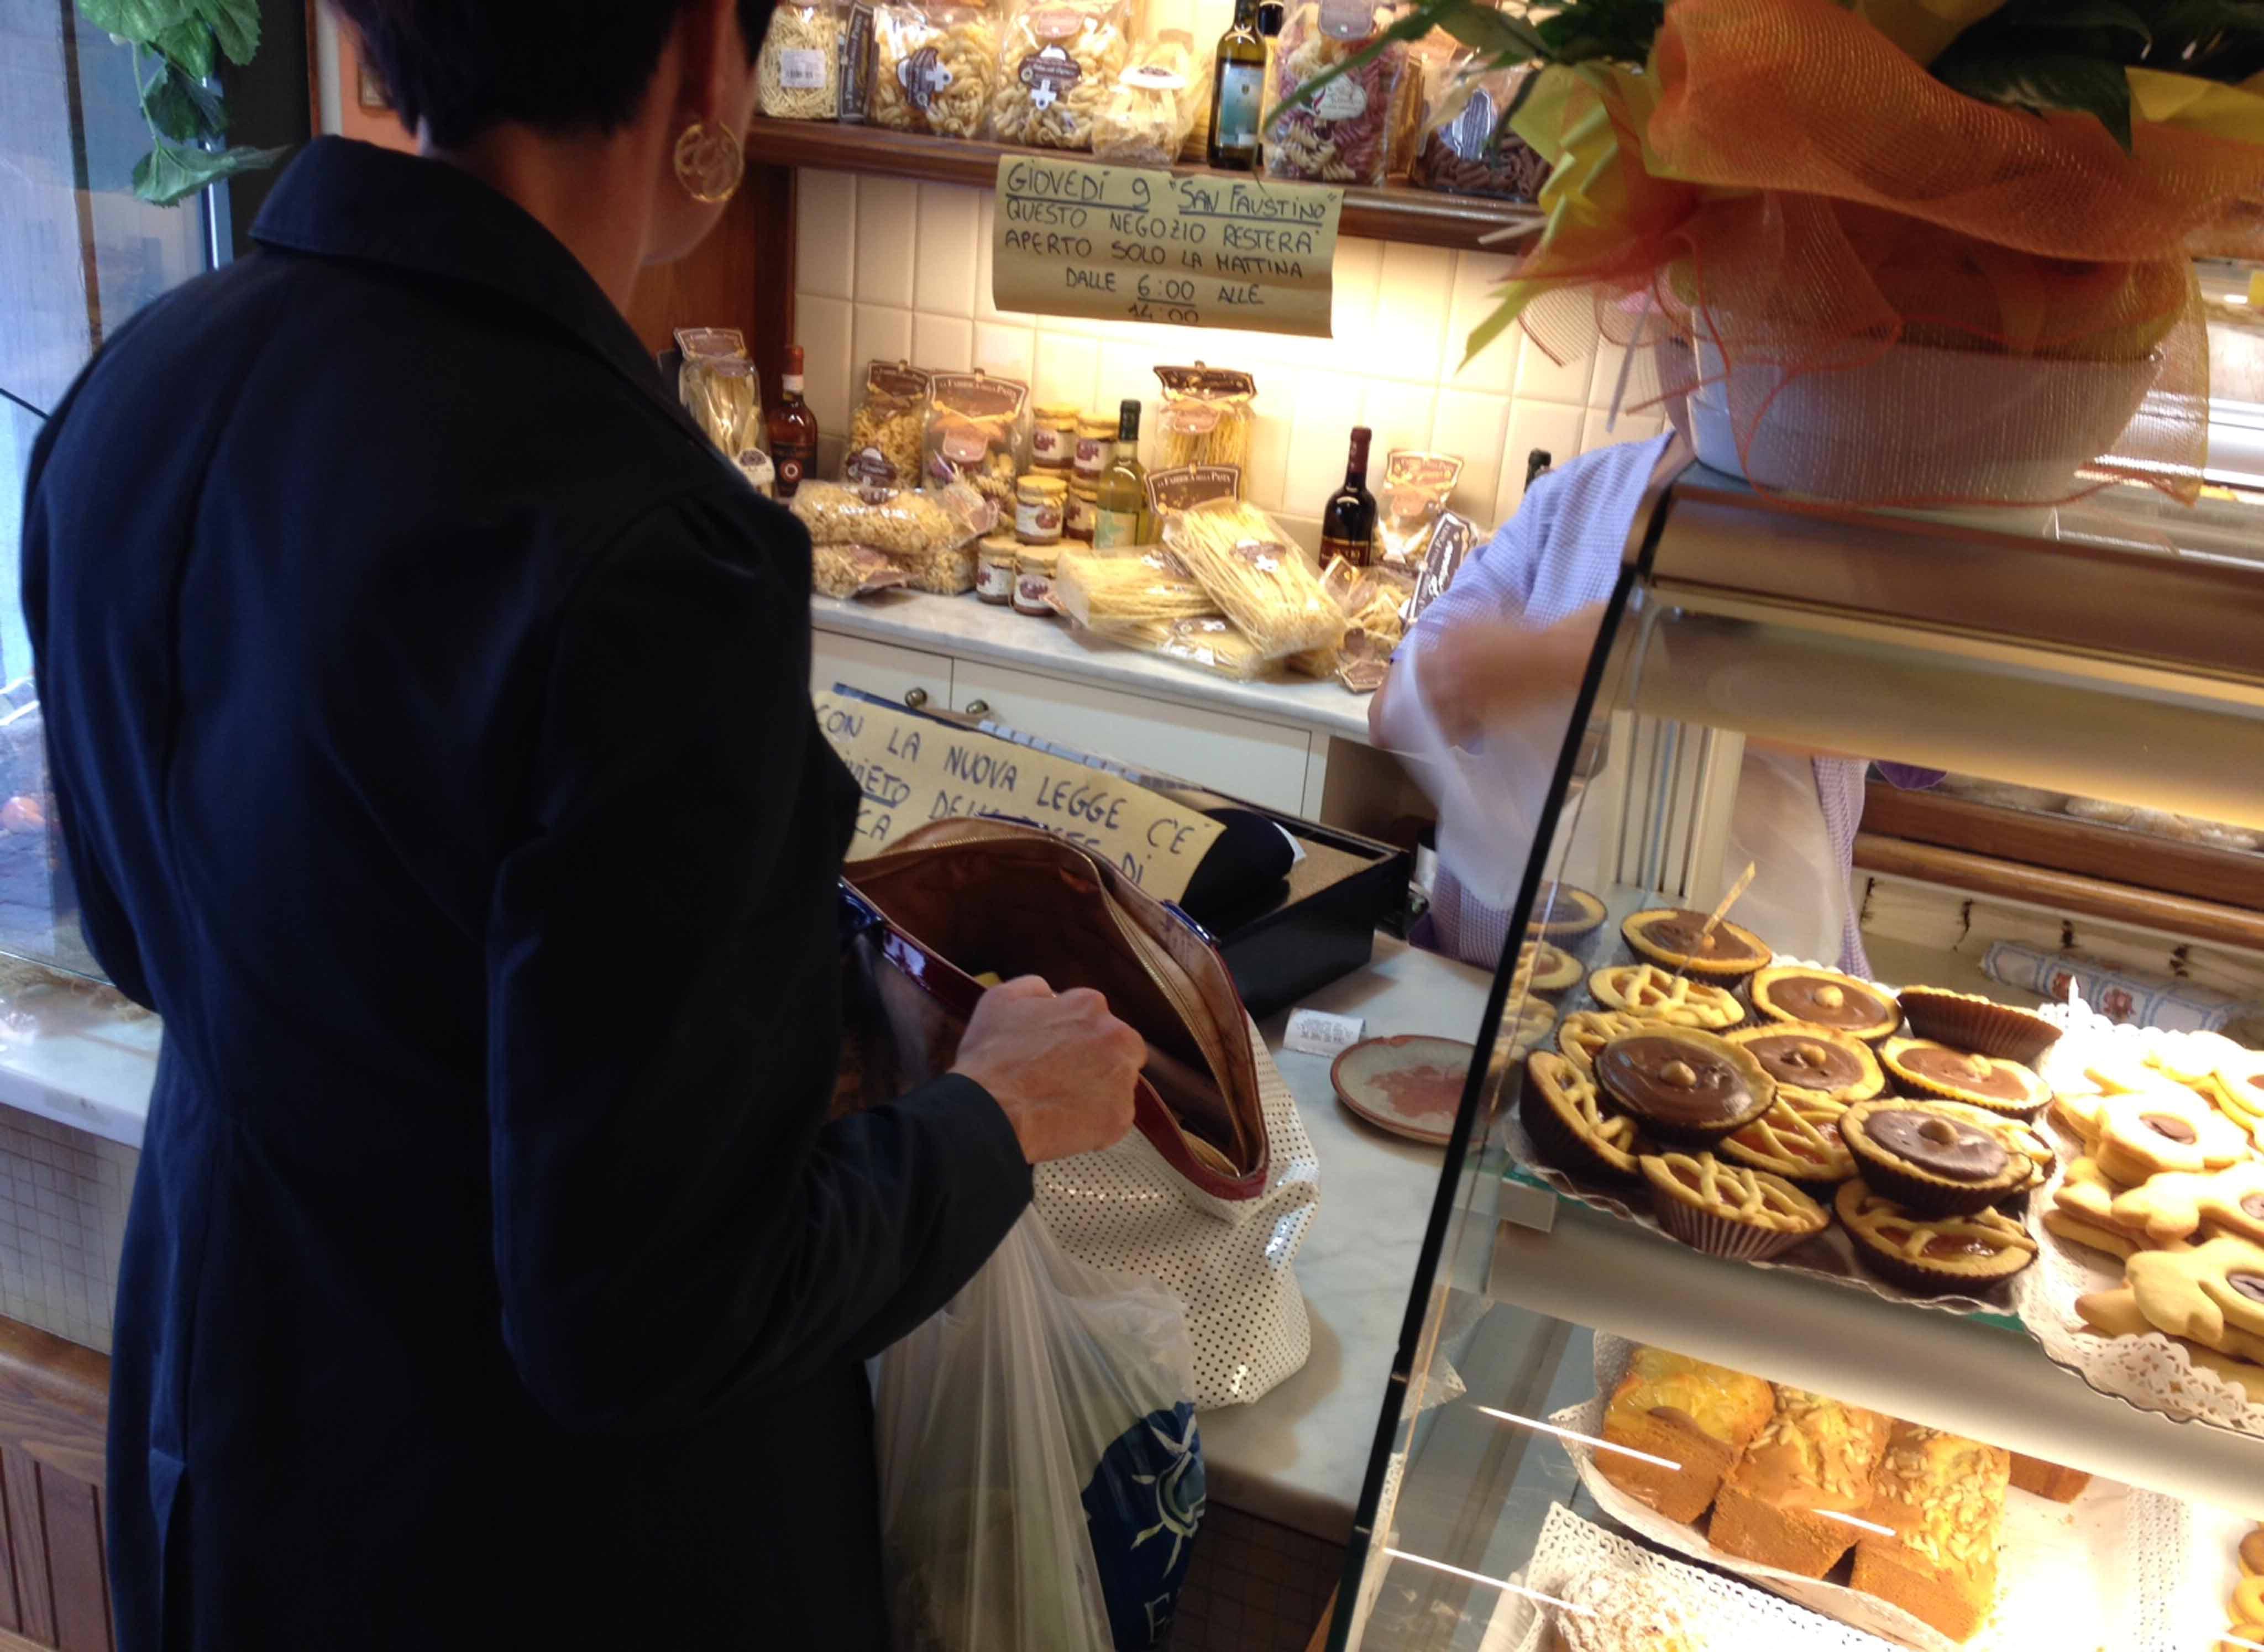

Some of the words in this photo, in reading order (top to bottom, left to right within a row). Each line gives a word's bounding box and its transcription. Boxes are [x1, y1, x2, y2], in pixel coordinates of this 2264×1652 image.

[1131, 177, 1151, 207] 9
[1006, 197, 1087, 229] QUESTO
[1110, 212, 1206, 244] NEGOZIO
[1005, 228, 1092, 258] APERTO
[1111, 240, 1166, 265] SOLO
[1181, 250, 1202, 269] LA
[1216, 253, 1303, 279] MATTINA
[1066, 266, 1117, 293] DALLE
[1217, 284, 1264, 305] ALLE
[887, 726, 920, 763] LA
[943, 746, 1018, 793] NUOVA
[1037, 775, 1126, 830] LEGGE
